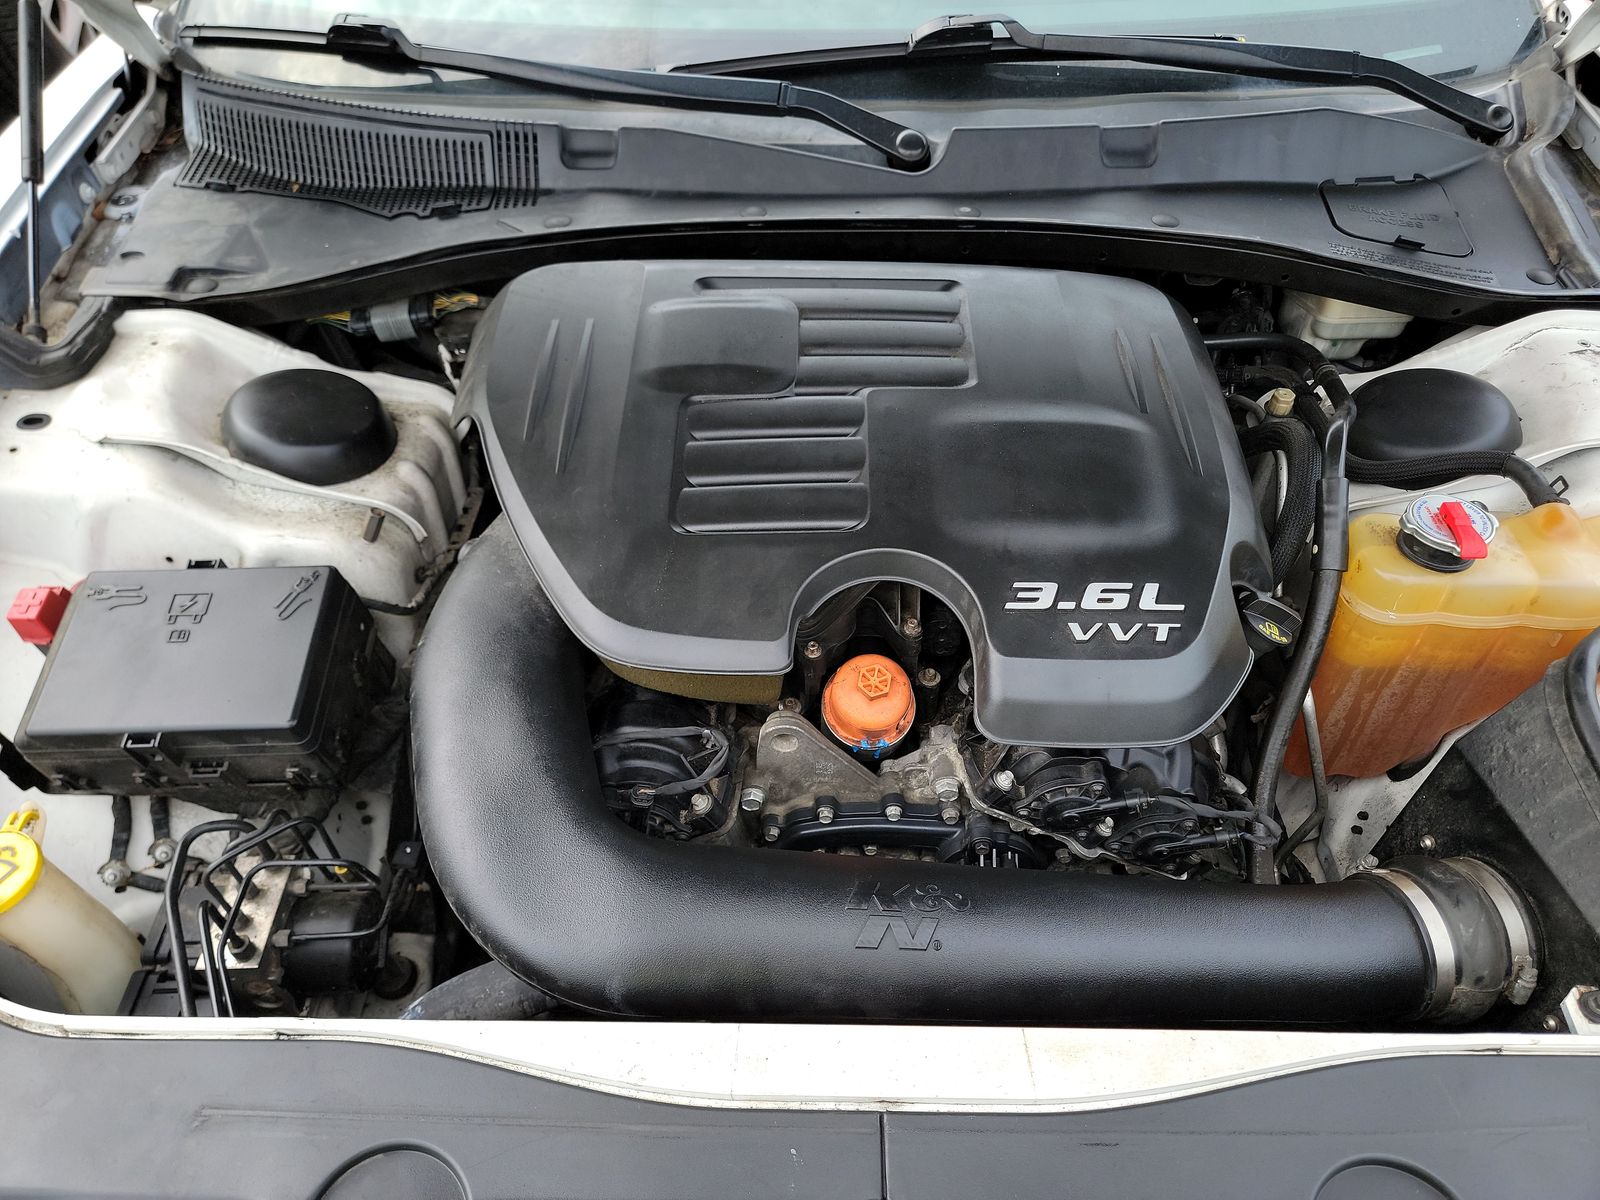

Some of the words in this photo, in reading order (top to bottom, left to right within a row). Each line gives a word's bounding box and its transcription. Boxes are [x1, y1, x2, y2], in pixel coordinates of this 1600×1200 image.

[1346, 202, 1396, 218] BRAKE
[1399, 208, 1441, 222] FLUID
[1366, 214, 1425, 229] ACCESS
[1004, 581, 1186, 611] 3.6L
[1067, 622, 1182, 643] VVT
